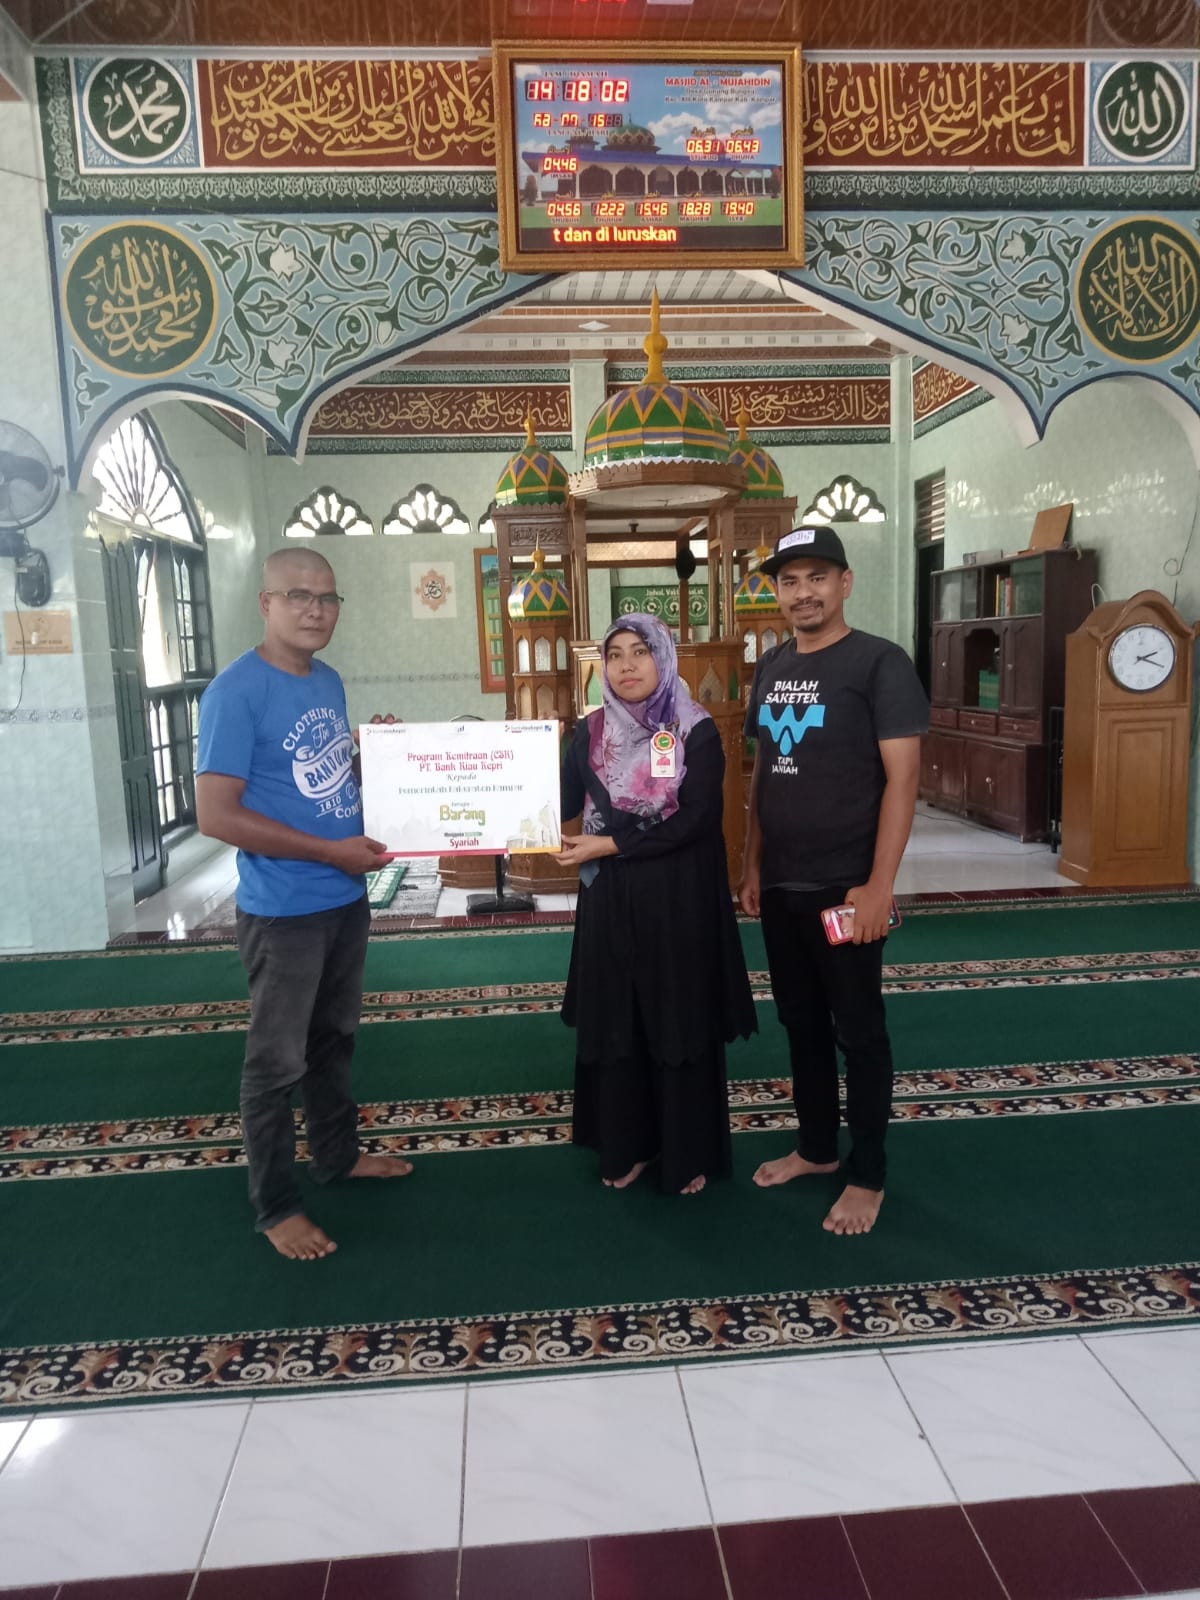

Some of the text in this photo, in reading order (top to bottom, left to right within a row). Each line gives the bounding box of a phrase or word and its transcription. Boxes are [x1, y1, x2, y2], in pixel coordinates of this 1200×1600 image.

[665, 78, 771, 86] MASJID AL MUJAHIDIN
[563, 227, 592, 242] dan
[596, 226, 609, 242] di
[613, 225, 677, 242] luruskan
[773, 680, 819, 692] BIALAH
[765, 693, 820, 703] SAKETEK
[282, 706, 337, 752] CLOTHING
[303, 745, 350, 789] BANDUN
[778, 756, 793, 766] TAPI
[439, 804, 486, 826] Barang
[449, 837, 480, 849] Syariah
